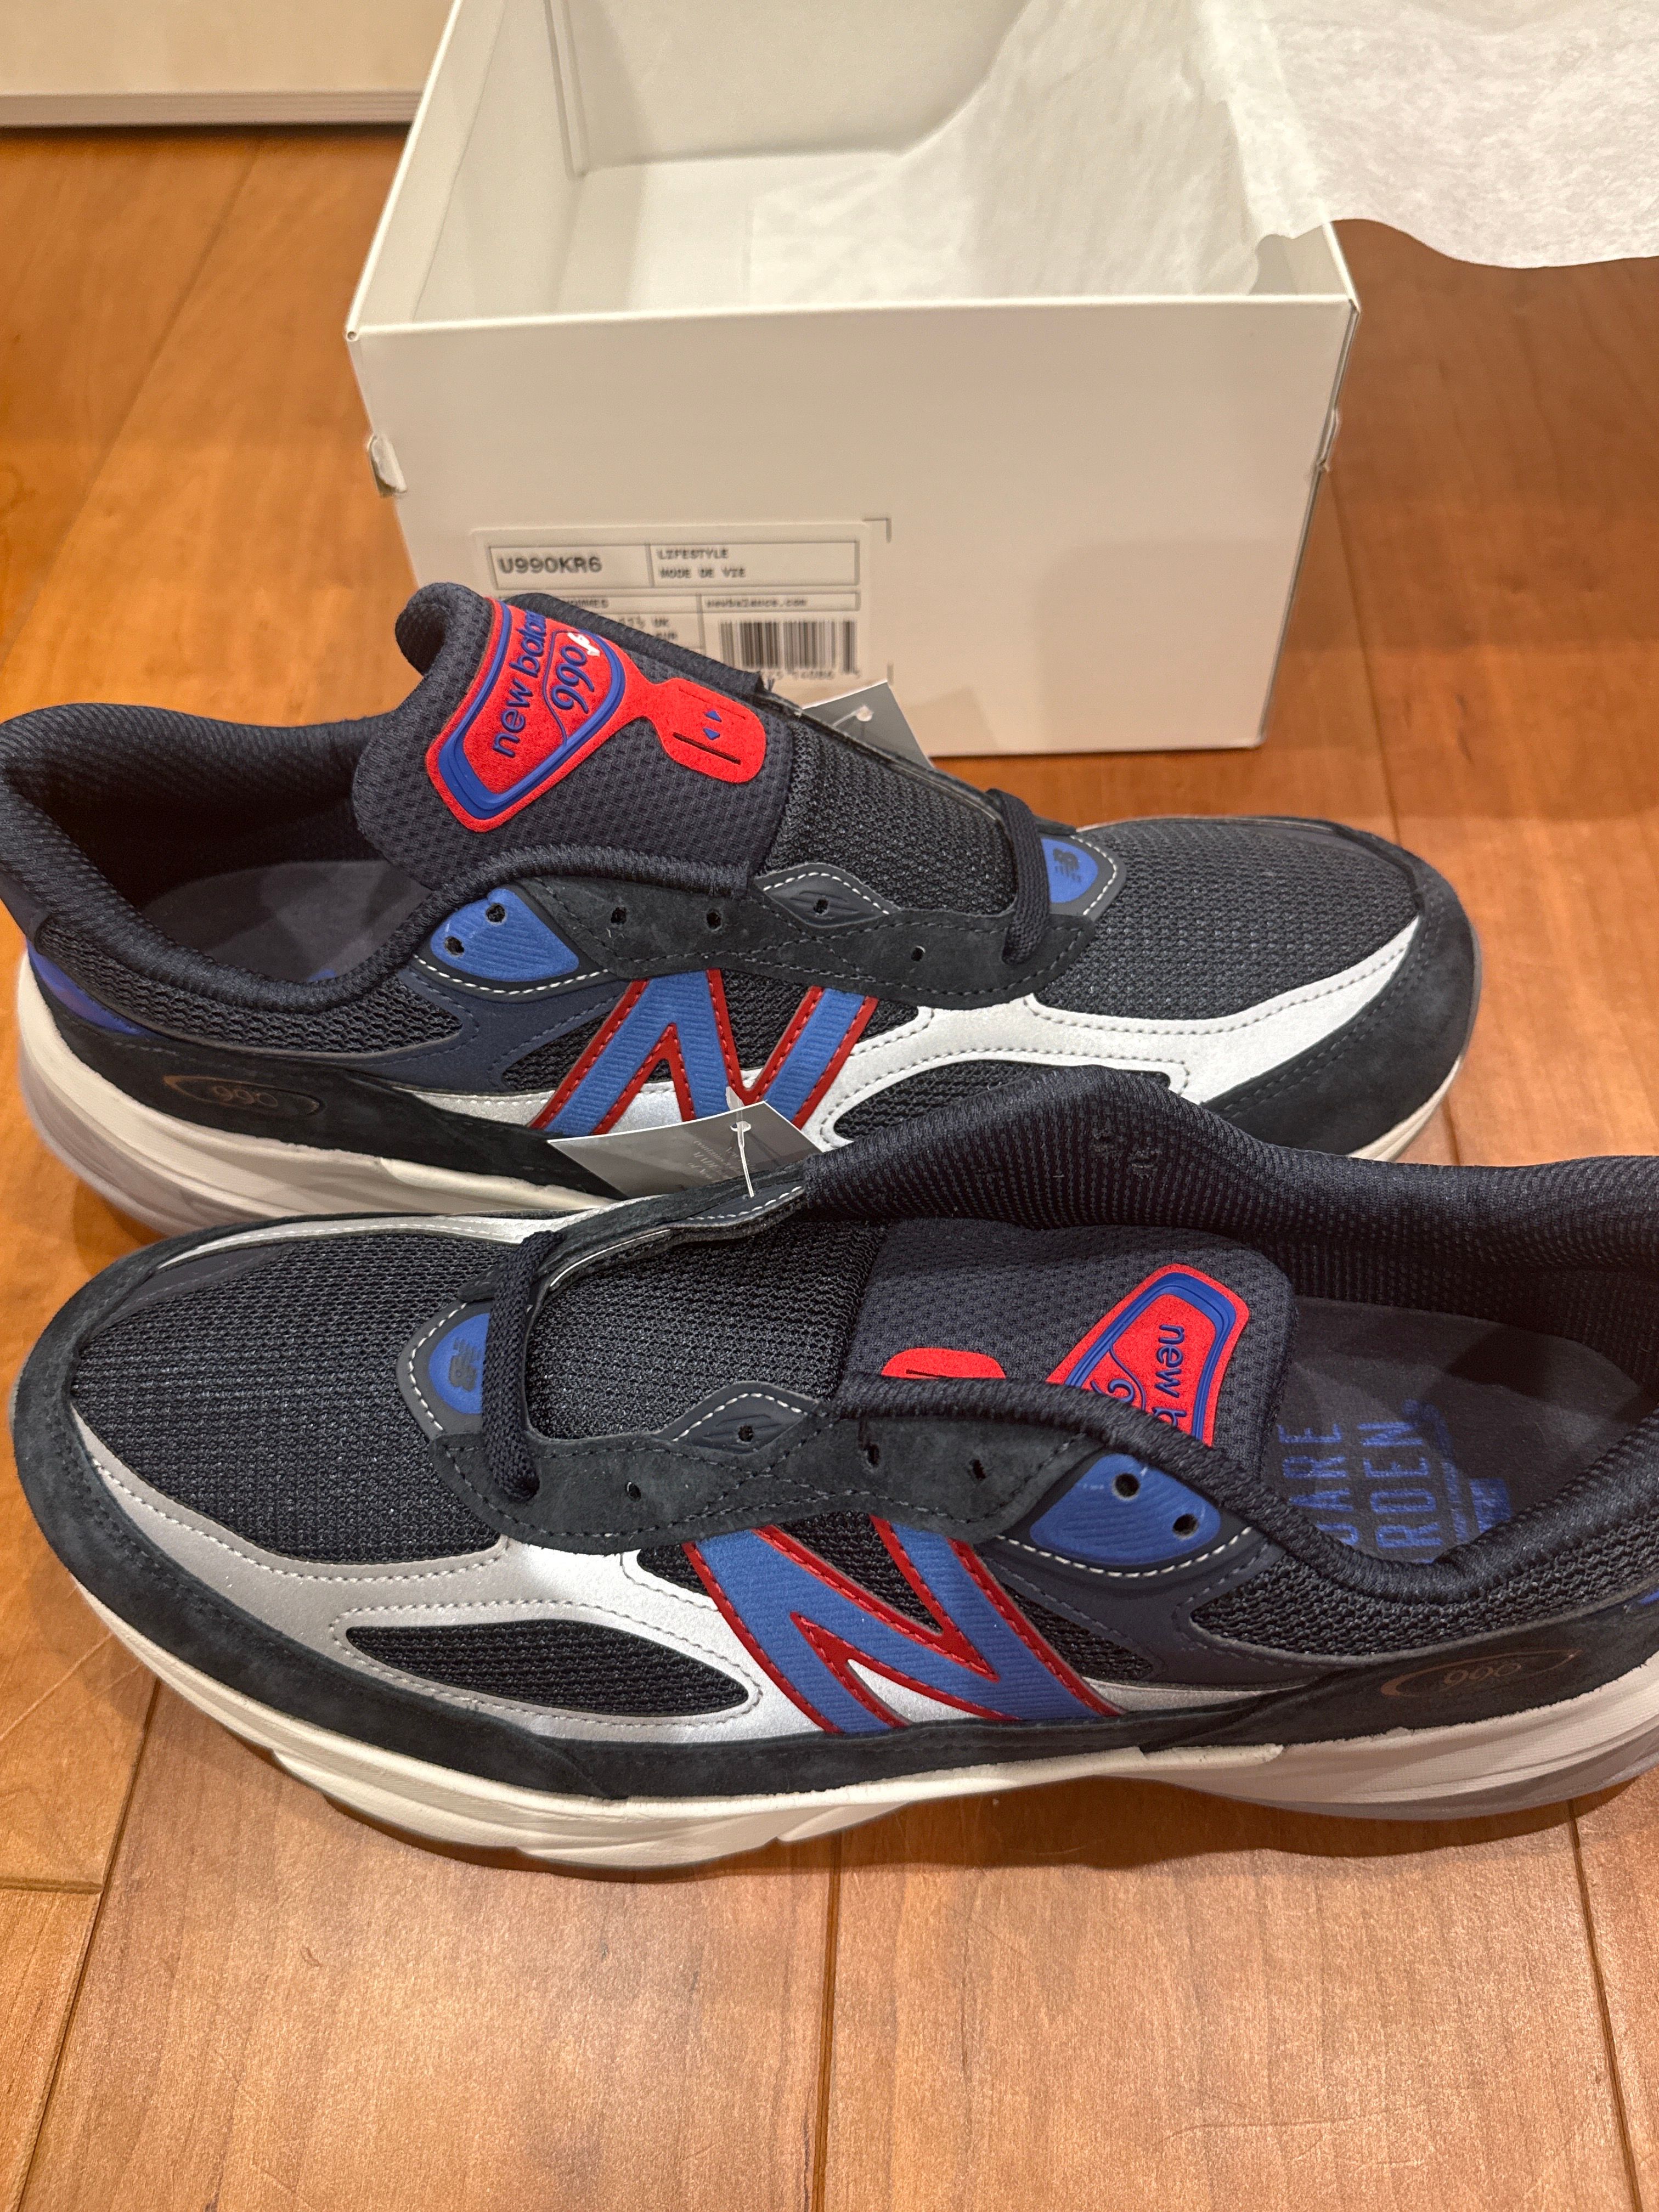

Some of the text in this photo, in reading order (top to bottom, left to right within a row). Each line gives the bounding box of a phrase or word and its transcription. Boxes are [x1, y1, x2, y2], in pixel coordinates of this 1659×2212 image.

[497, 555, 603, 574] U990KR6
[657, 548, 729, 560] LIFESTYLE
[659, 567, 746, 579] MODE DE VIE
[493, 609, 548, 758] new balan
[1154, 1324, 1186, 1398] new
[1356, 1421, 1444, 1550] RDEN
